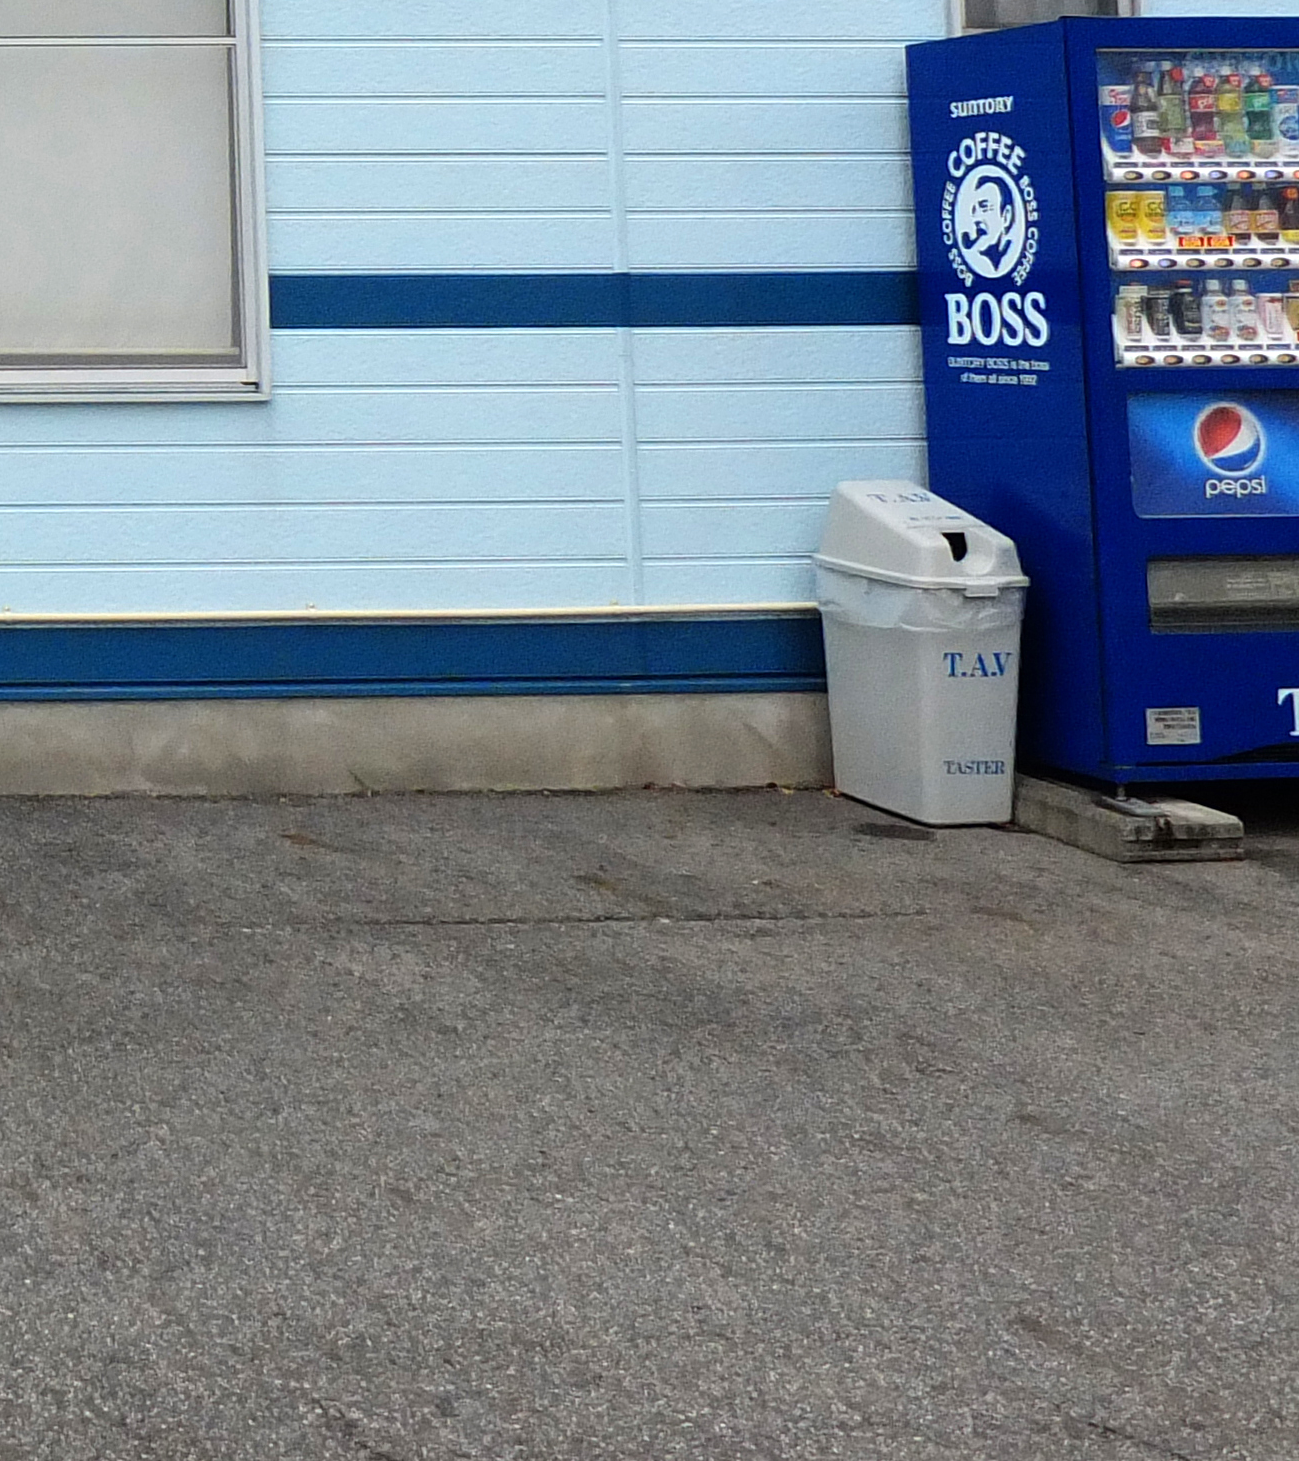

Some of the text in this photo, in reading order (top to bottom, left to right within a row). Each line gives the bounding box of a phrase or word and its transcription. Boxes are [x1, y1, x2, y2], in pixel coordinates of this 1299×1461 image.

[949, 95, 1014, 118] SUNTORY
[947, 131, 1027, 178] COFFEE
[941, 180, 957, 245] COFFEE
[943, 291, 1048, 347] BOSS
[1204, 475, 1267, 499] pepsi
